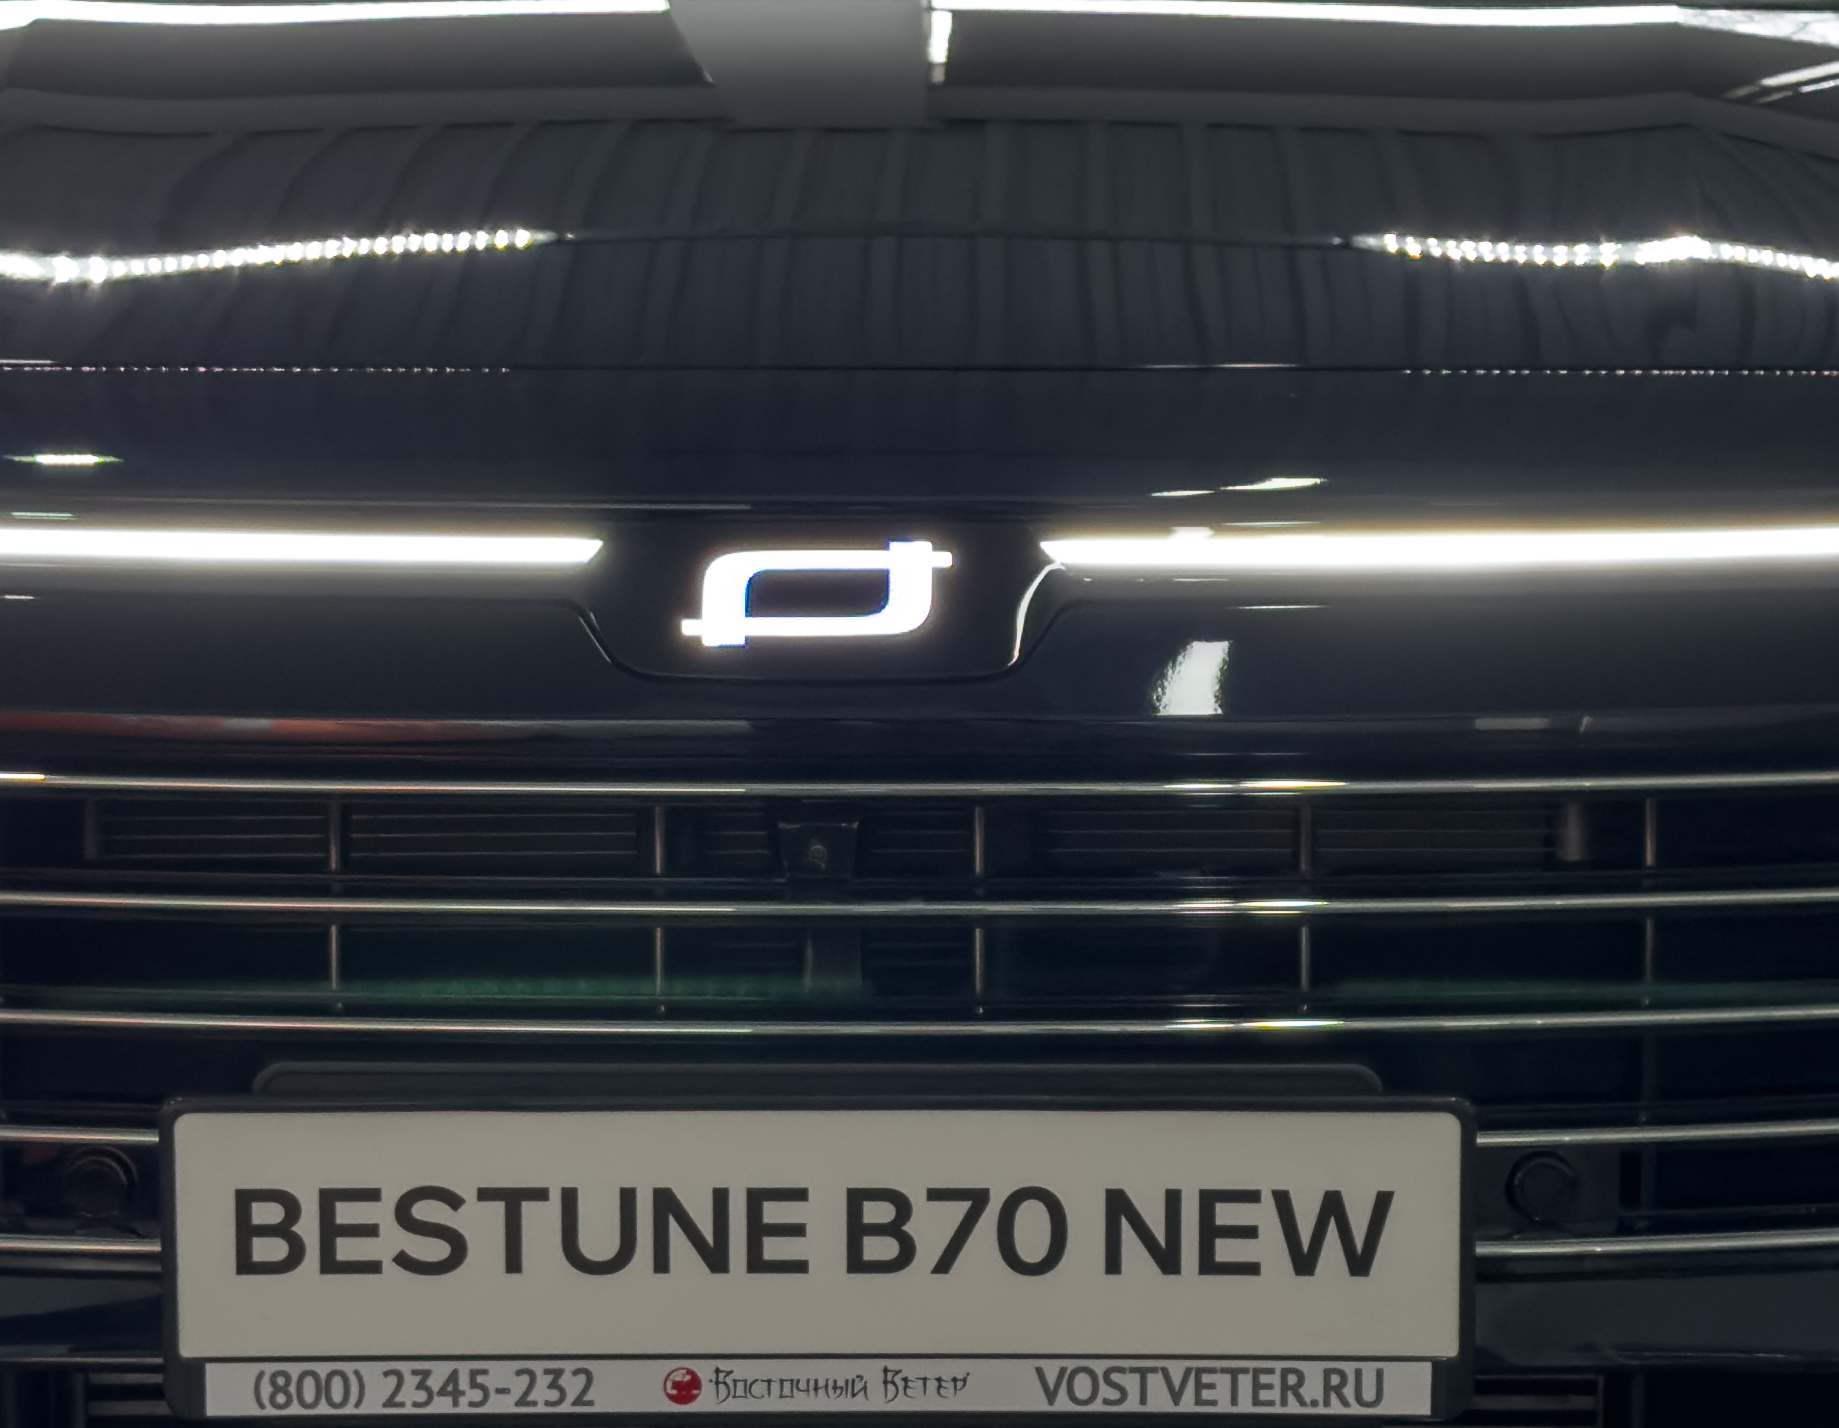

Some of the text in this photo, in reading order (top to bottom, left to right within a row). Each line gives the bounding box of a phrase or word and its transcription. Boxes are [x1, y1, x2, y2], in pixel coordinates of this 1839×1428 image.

[234, 1184, 1396, 1278] BESTUNE B70 NEW
[252, 1366, 597, 1411] (800) 2345-232
[1033, 1365, 1386, 1409] VOSTVETER.RU
